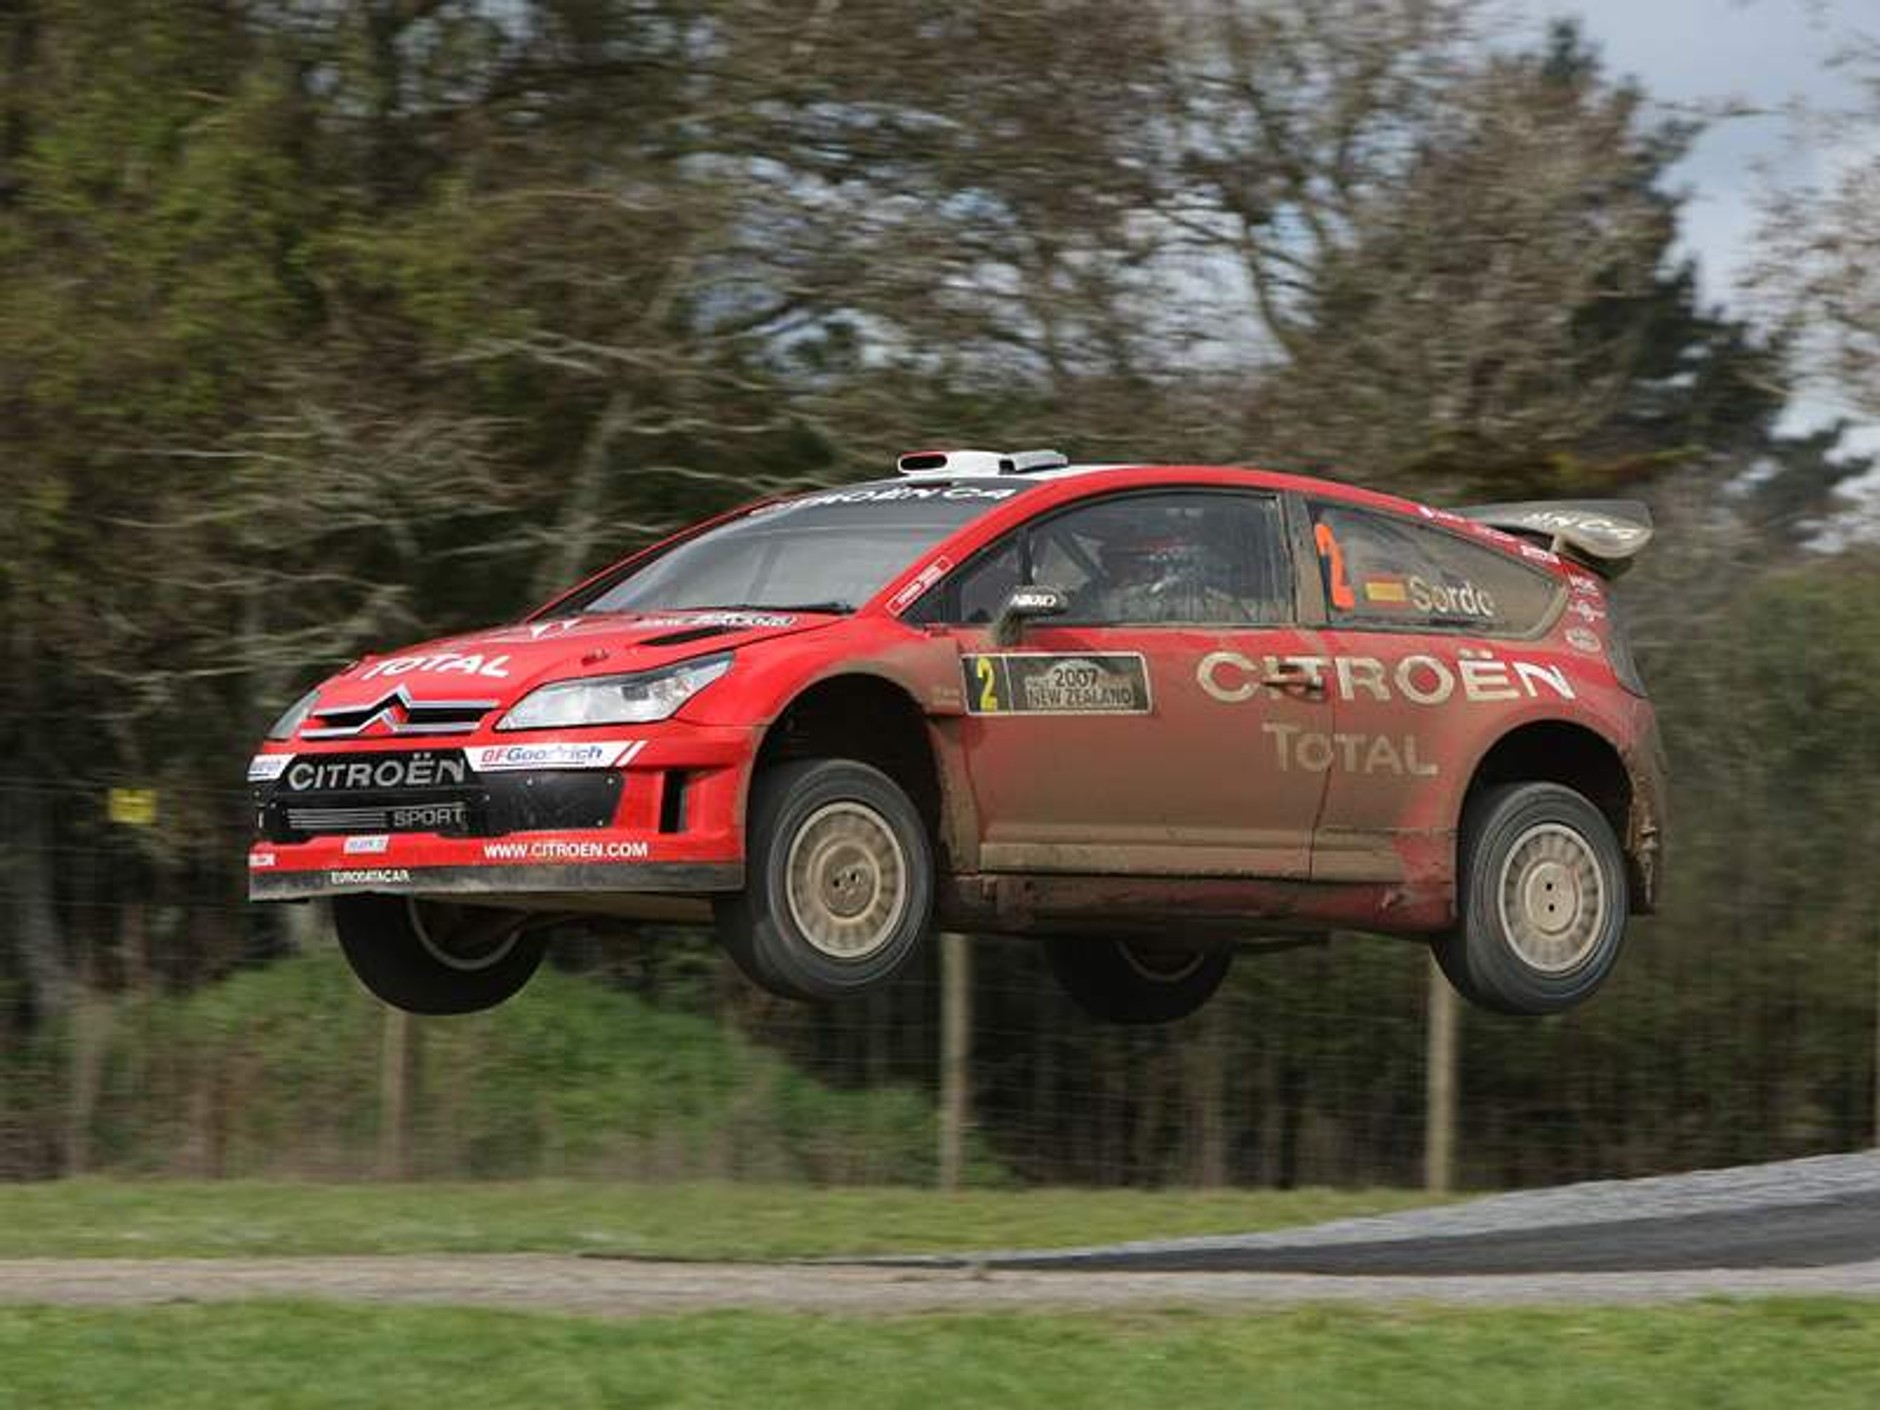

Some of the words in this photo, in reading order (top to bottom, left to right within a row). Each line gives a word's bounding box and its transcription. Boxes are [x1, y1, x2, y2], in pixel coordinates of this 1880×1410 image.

[1314, 523, 1354, 610] 2
[362, 652, 511, 678] TOTAL
[976, 657, 998, 712] 2
[1054, 667, 1097, 687] 2007
[1197, 648, 1576, 705] CITROËN
[1028, 687, 1062, 706] NEW
[1065, 687, 1132, 705] ZEALAND
[1261, 722, 1438, 776] TOTAL
[287, 752, 465, 791] CITROËN
[393, 807, 464, 827] SPORT
